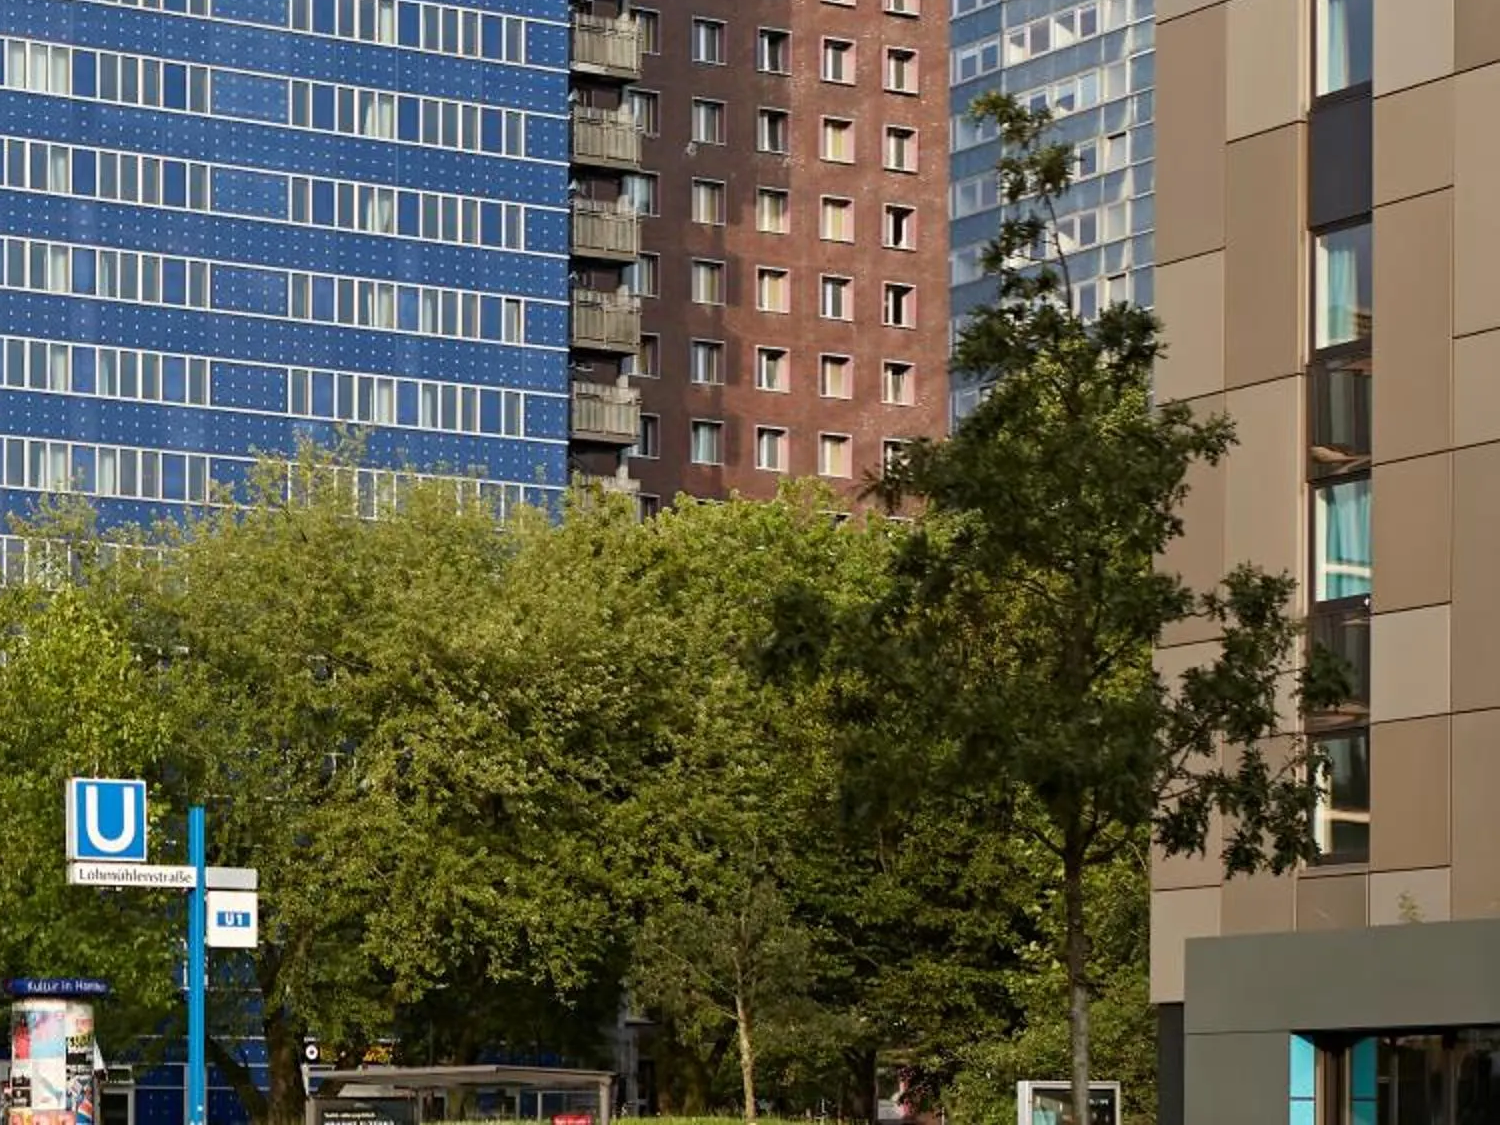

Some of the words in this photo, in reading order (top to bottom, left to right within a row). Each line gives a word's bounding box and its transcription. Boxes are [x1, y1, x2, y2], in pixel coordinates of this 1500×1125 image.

[85, 785, 135, 853] U
[79, 867, 193, 884] Lohmühlenstraße
[225, 913, 243, 925] U1
